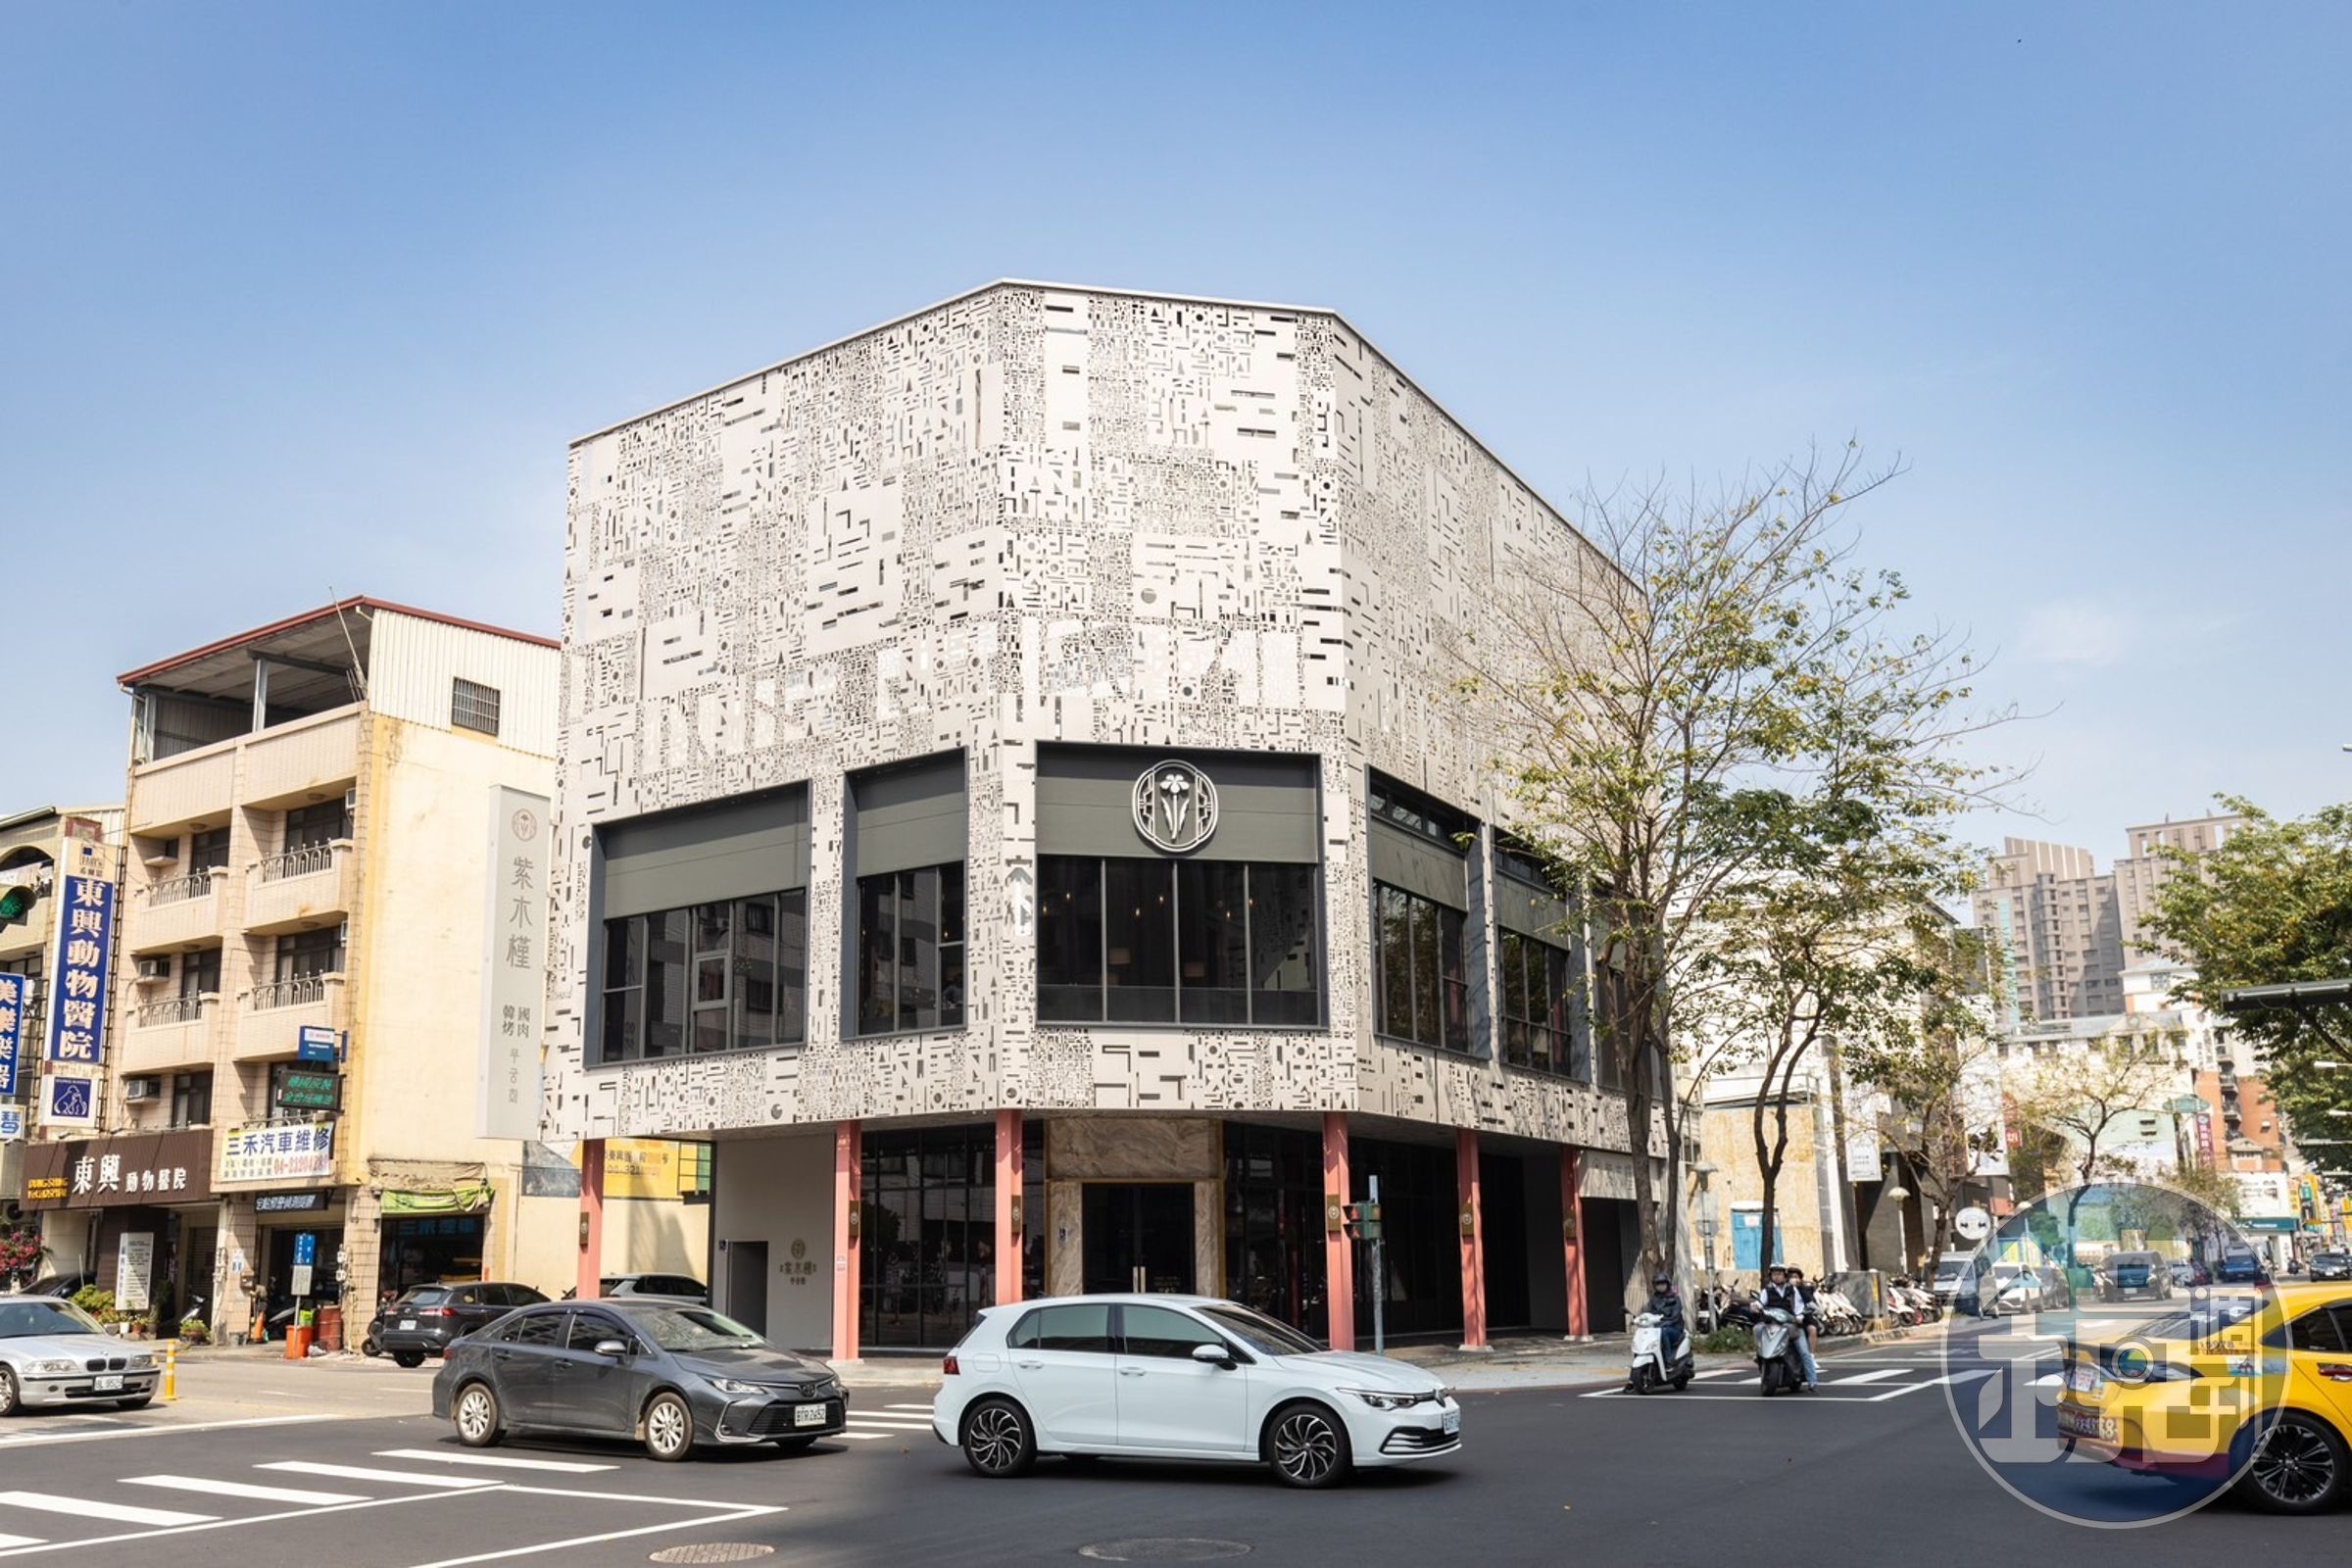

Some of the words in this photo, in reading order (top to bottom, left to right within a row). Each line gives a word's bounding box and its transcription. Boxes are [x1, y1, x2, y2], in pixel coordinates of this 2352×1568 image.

[506, 857, 535, 969] 紫木槿
[59, 878, 106, 1060] 東興動物醫院
[72, 1153, 187, 1196] 東興動物醫院
[226, 1128, 330, 1156] 三禾汽車維修
